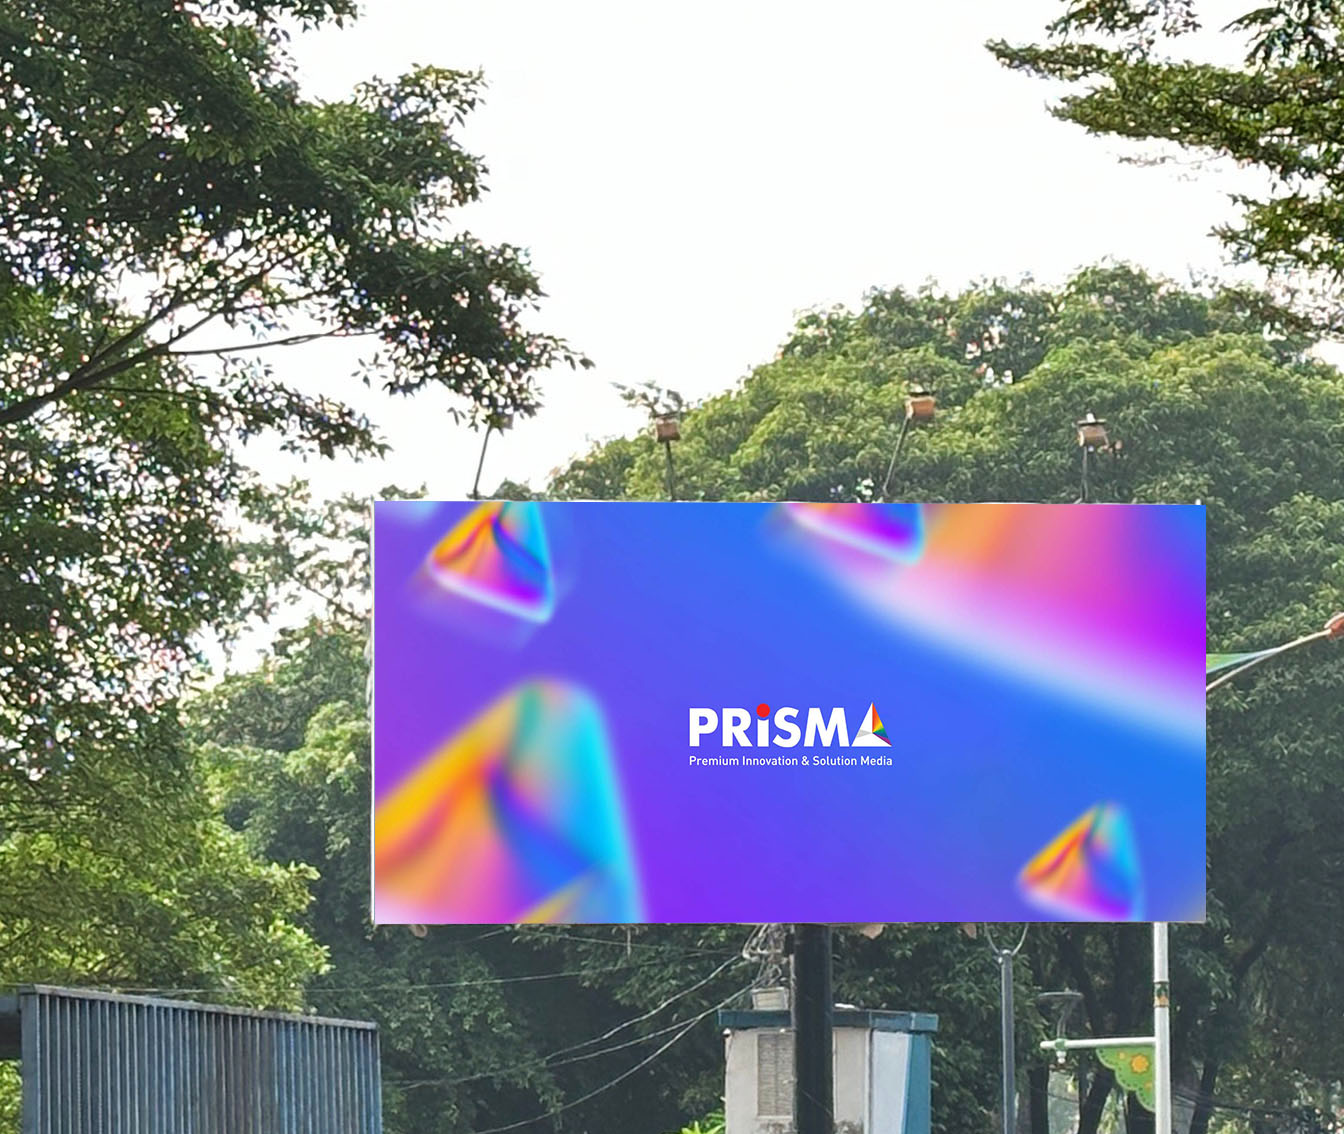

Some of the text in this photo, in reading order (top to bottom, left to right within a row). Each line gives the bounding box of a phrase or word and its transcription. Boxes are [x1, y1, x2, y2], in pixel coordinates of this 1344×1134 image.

[689, 756, 893, 766] Premium Innovation & Solution Media
